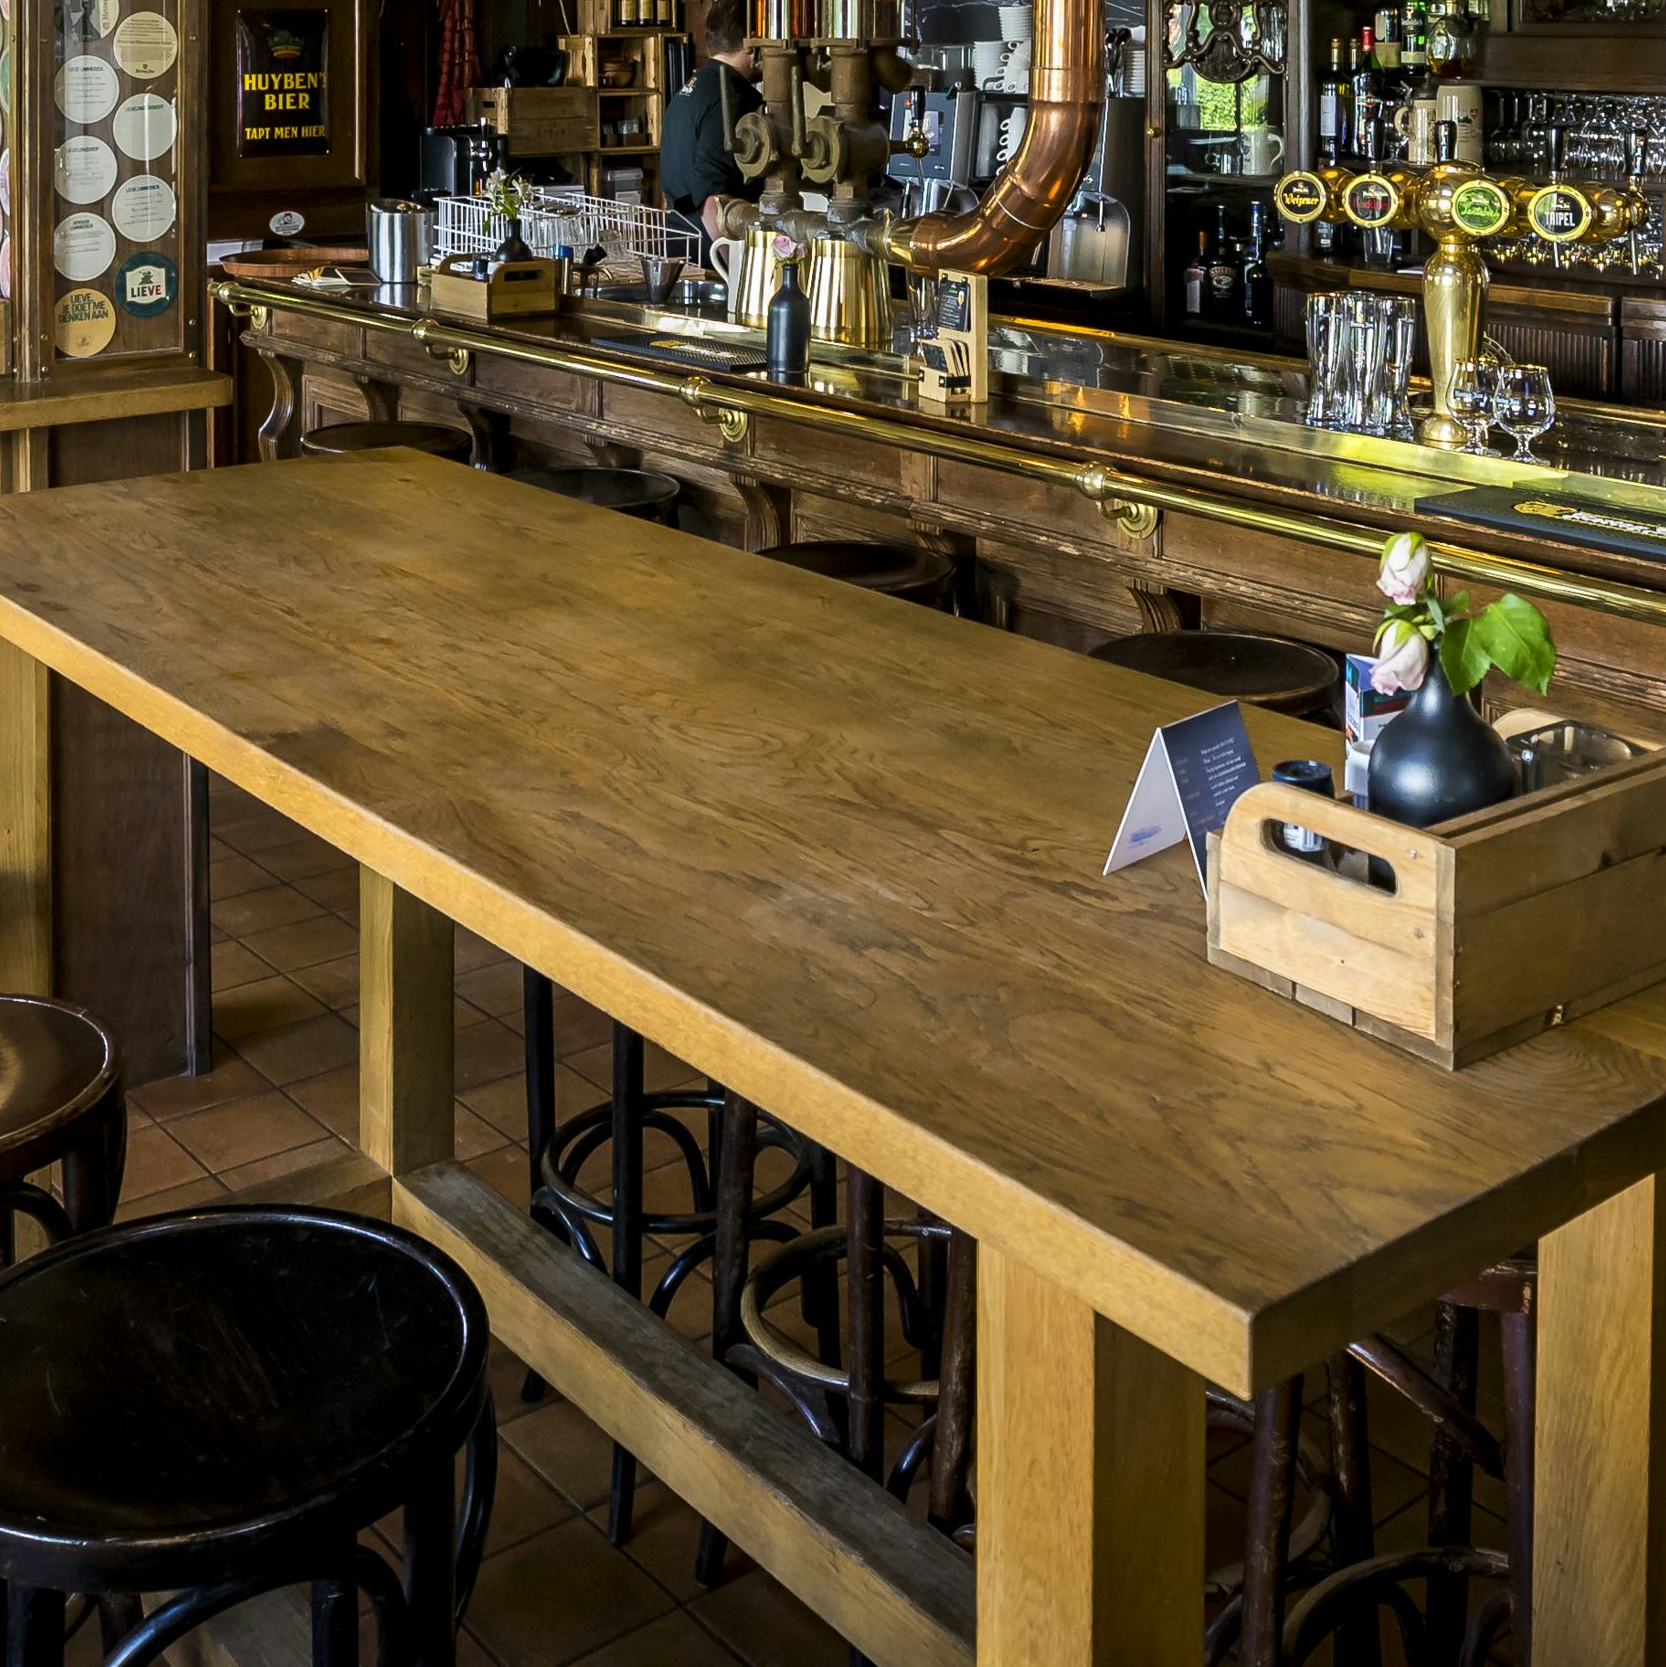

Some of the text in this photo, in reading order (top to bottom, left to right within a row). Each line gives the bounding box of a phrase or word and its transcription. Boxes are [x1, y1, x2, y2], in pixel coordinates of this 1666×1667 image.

[264, 92, 311, 110] BIER
[245, 125, 326, 140] TAPT MEN HIER
[1284, 193, 1320, 207] Weizener
[1544, 212, 1576, 228] TRIPEL
[130, 284, 162, 298] LIEVE
[62, 301, 106, 314] JE DOET ME
[58, 309, 109, 323] DENKEN AAN
